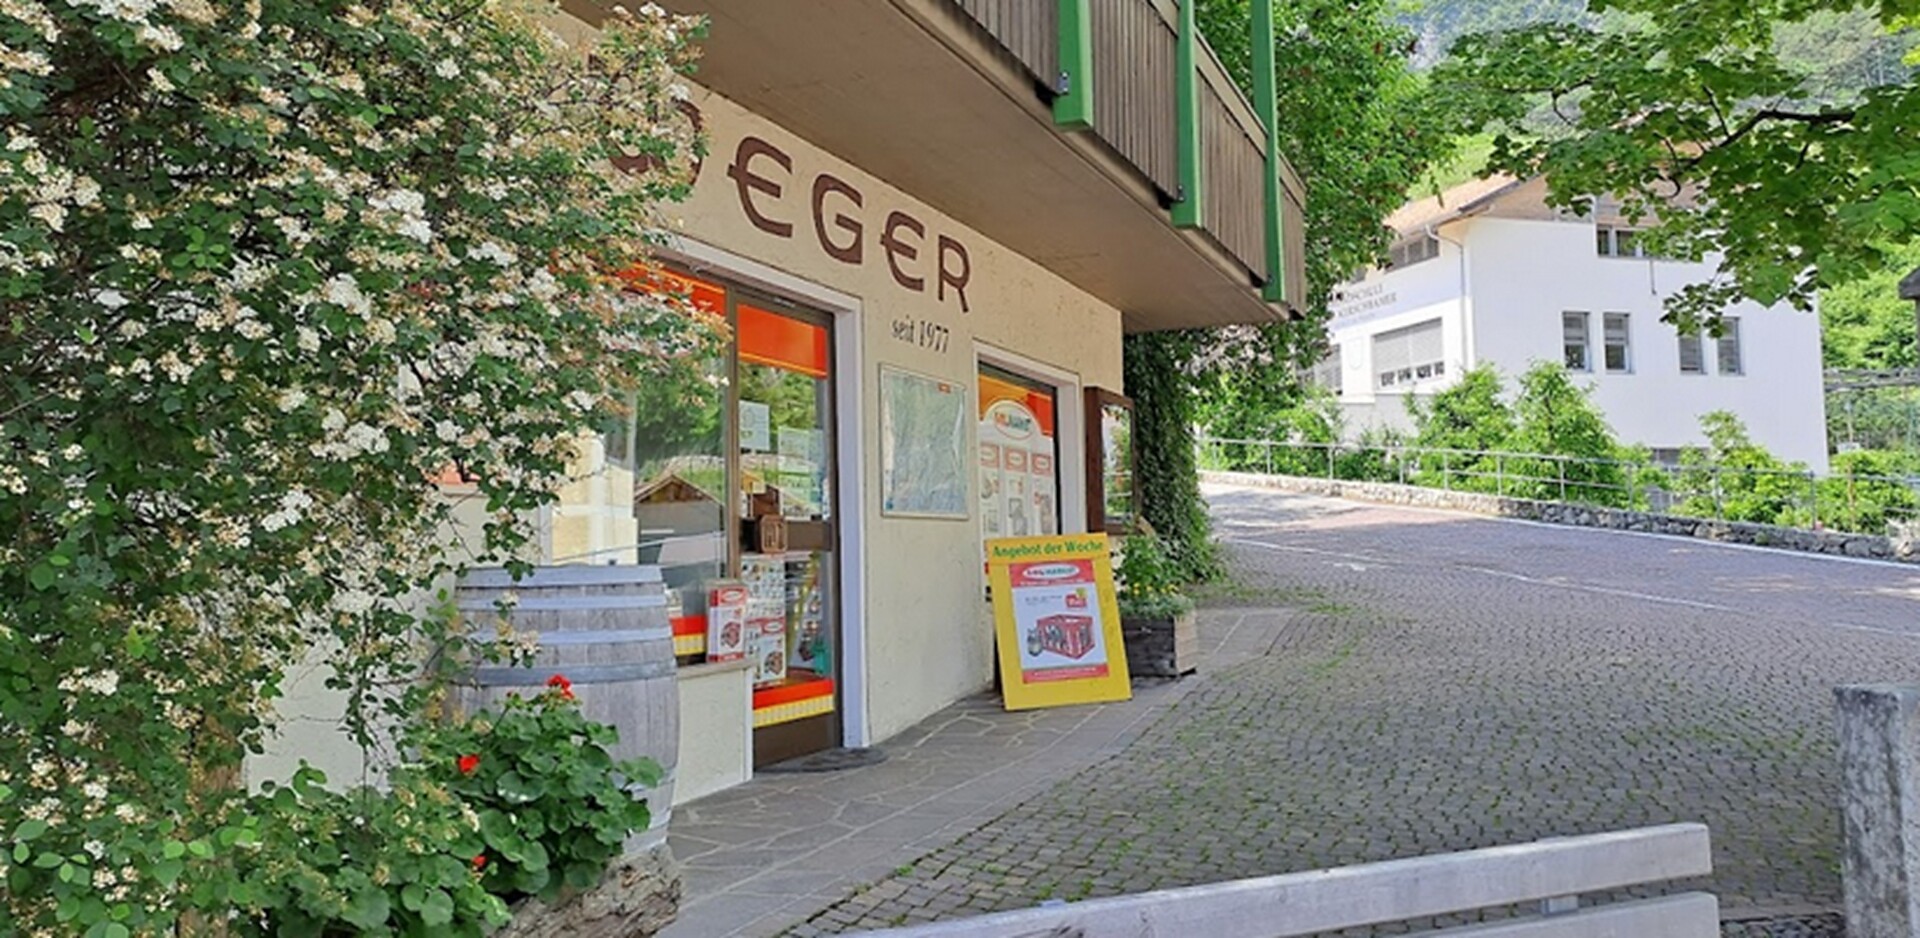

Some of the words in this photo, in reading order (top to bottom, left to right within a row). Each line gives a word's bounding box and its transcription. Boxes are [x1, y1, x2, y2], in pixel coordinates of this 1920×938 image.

[891, 314, 914, 344] seit
[919, 320, 949, 354] 1977
[993, 544, 1041, 558] Angebot
[1043, 543, 1062, 555] der
[1064, 540, 1103, 553] Woche
